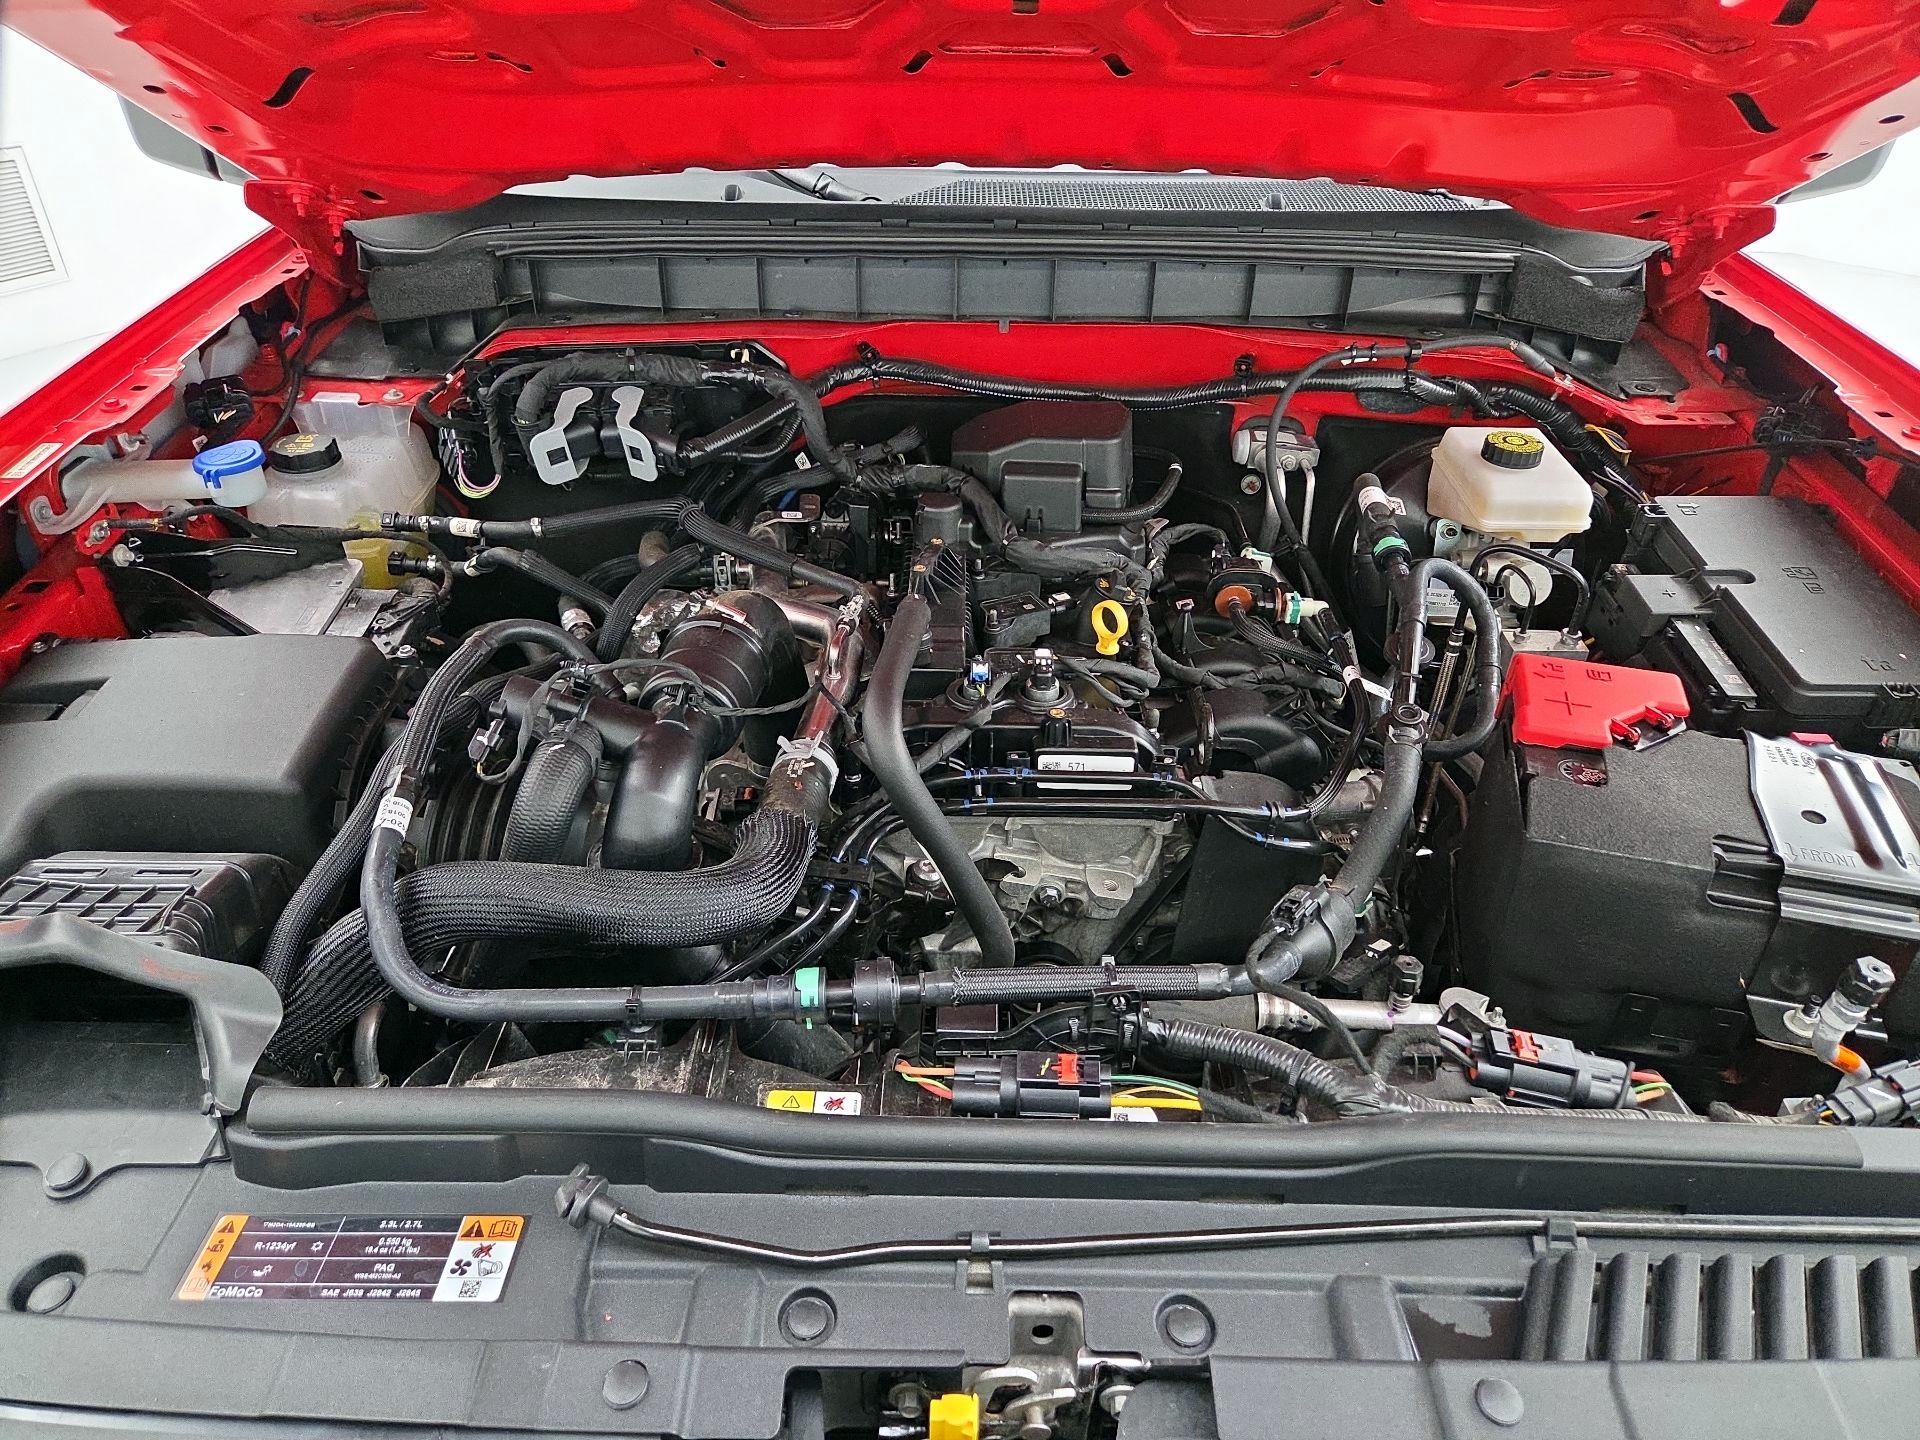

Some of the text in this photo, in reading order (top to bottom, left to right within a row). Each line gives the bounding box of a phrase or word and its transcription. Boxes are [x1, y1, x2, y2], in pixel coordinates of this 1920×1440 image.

[1068, 762, 1086, 771] 571
[1800, 847, 1857, 869] FRONT
[380, 1219, 398, 1229] 2.3L
[404, 1219, 423, 1229] 2.7L
[254, 1241, 298, 1252] R-1234yf
[378, 1236, 413, 1247] 0.550 kg
[373, 1263, 396, 1273] PAG
[209, 1286, 264, 1298] FoMoCo
[321, 1288, 341, 1297] SAE
